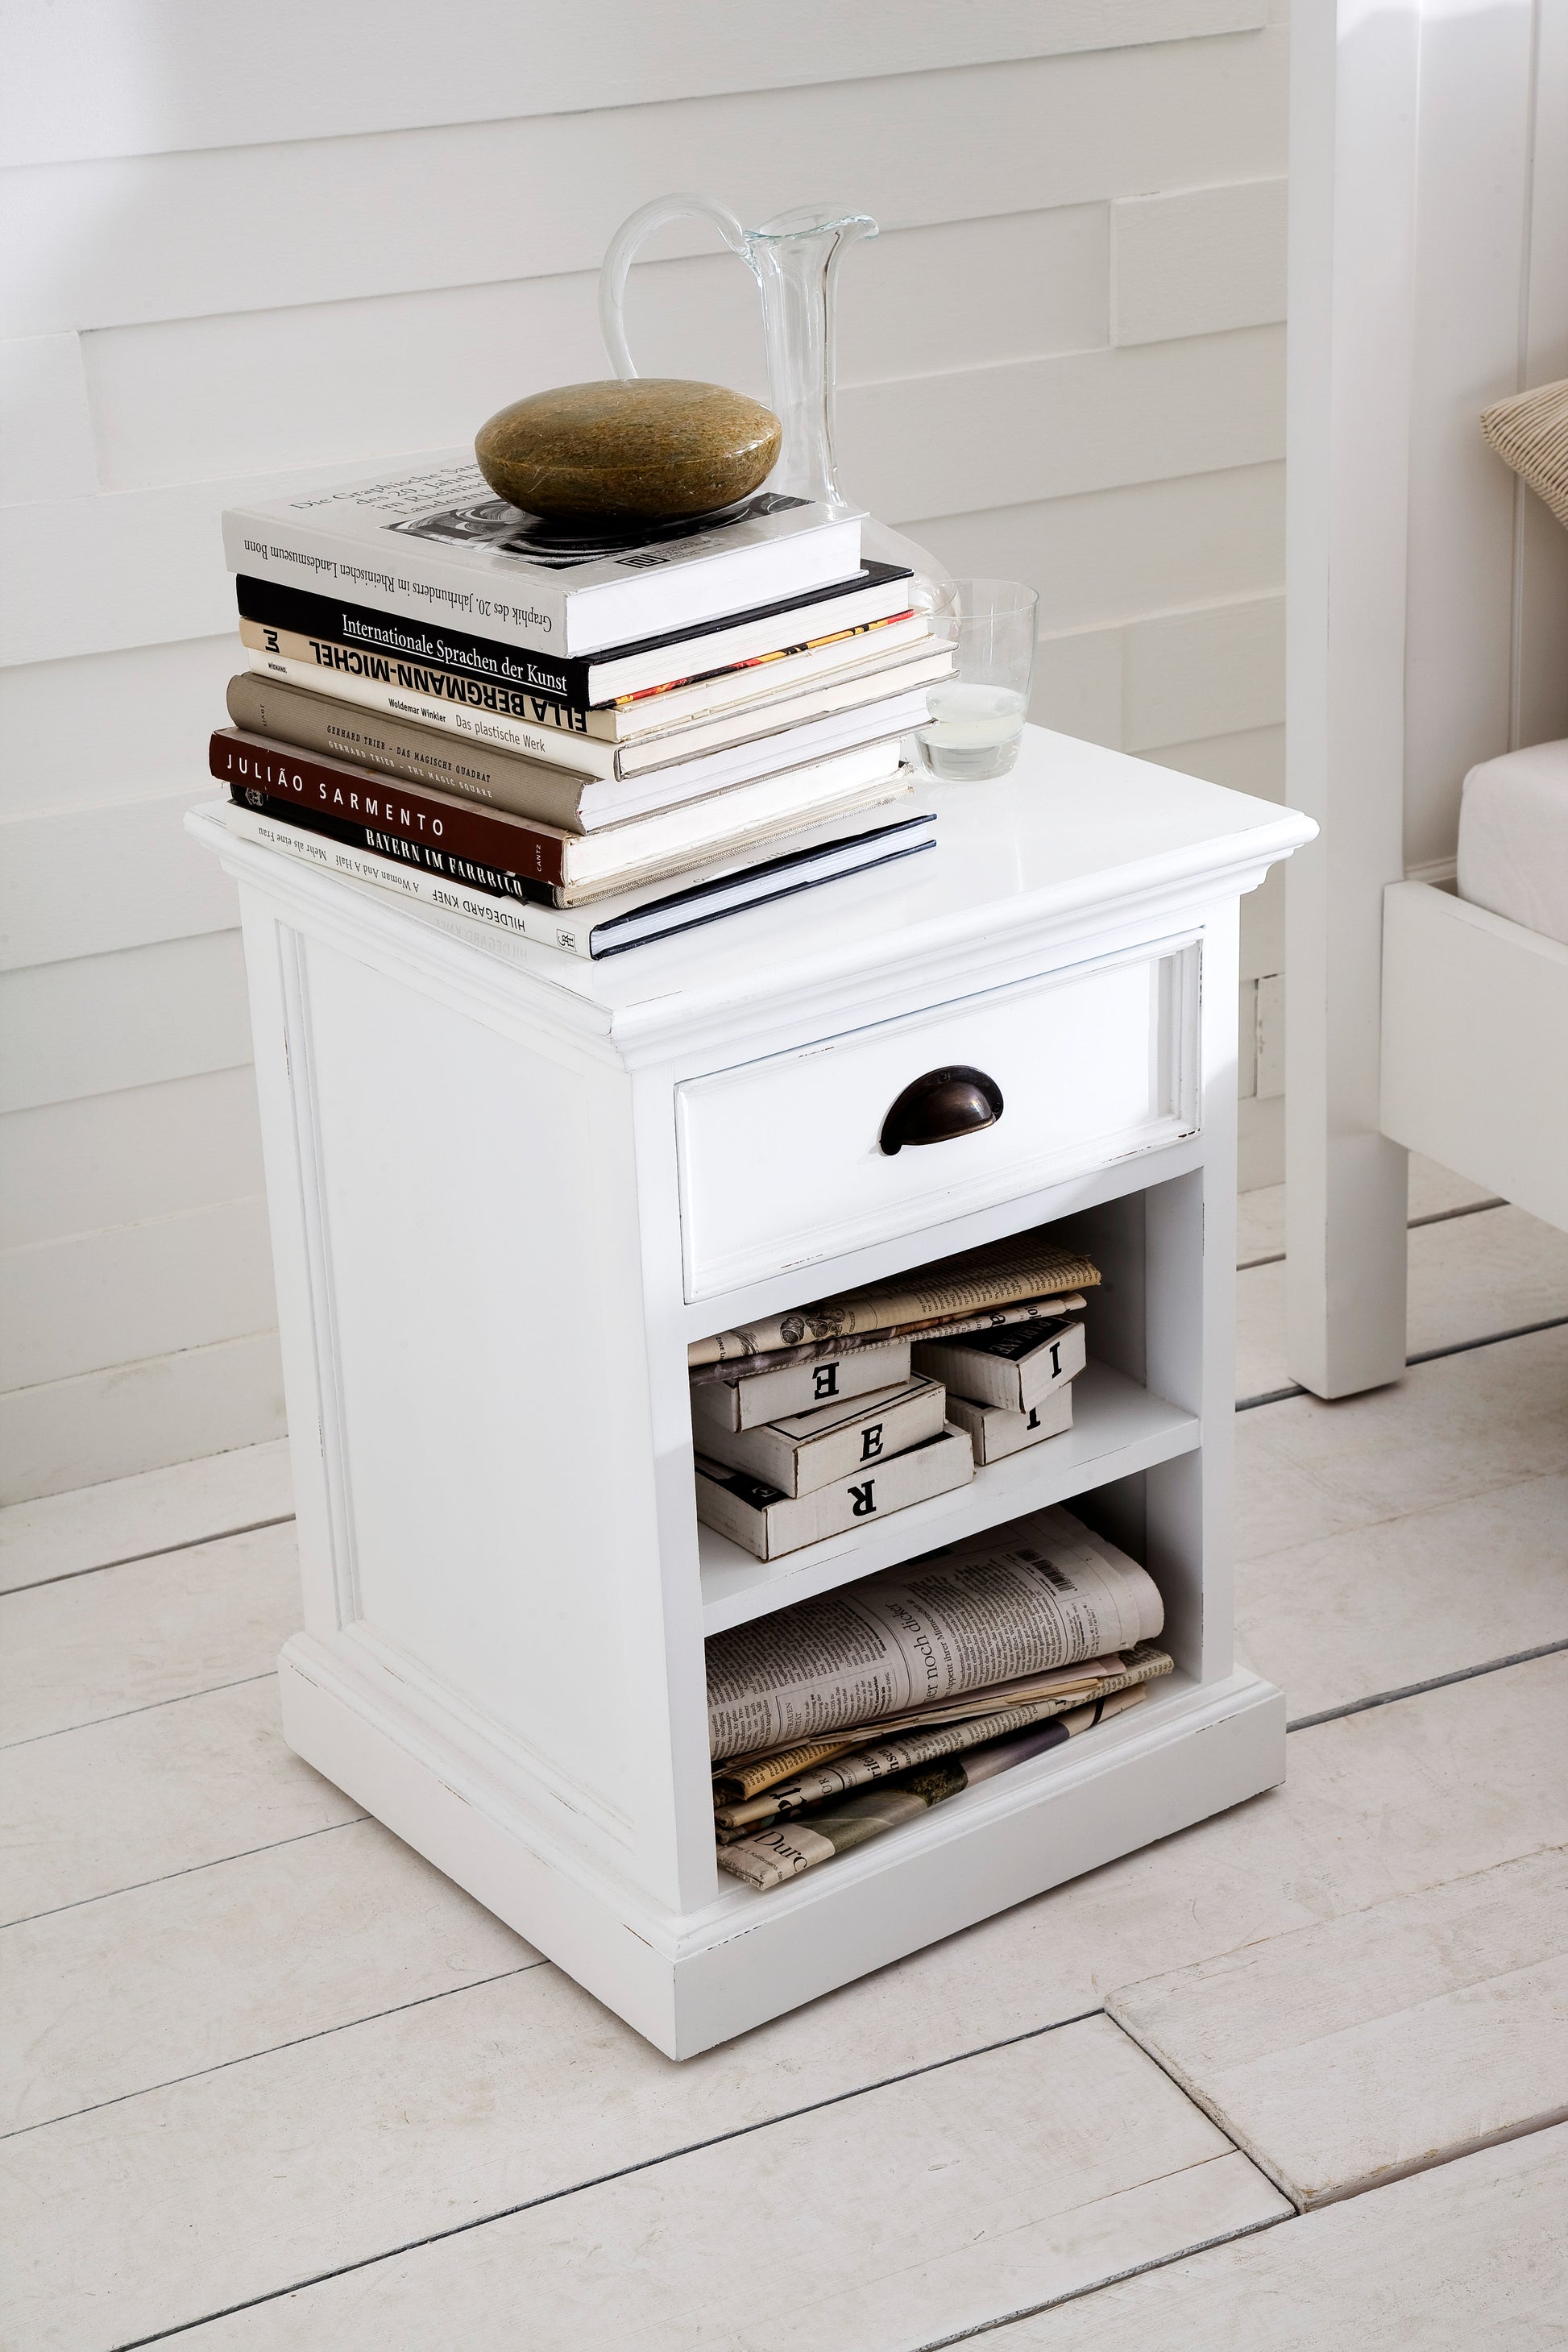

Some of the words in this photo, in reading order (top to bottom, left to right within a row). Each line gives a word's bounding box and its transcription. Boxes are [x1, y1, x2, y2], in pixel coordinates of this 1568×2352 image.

[288, 497, 332, 510] Die
[333, 473, 442, 500] Graphische
[355, 495, 389, 506] des
[371, 500, 405, 510] im
[243, 539, 268, 560] Bonn
[271, 546, 338, 578] Landesmuseum
[340, 564, 395, 593] Rheinischen
[397, 579, 410, 597] im
[413, 583, 474, 613] Jahrhunderts
[494, 603, 509, 622] des
[512, 607, 552, 633] Graphik
[341, 613, 433, 655] Internationale
[437, 639, 498, 673] Sprachen
[501, 657, 524, 679] der
[526, 663, 568, 692] Kunst
[309, 641, 526, 718] BERGMANN-MICHEL
[388, 697, 420, 716] Woldemar
[421, 707, 446, 724] Winkler
[530, 696, 588, 733] ELLA
[455, 714, 472, 732] Das
[475, 721, 521, 745] plastische
[522, 733, 546, 753] Werk
[326, 724, 361, 742] GERHARD
[363, 736, 386, 751] TRIEB
[396, 746, 411, 759] DAS
[414, 752, 452, 771] MAGISCHE
[455, 765, 492, 783] QUADRAT
[328, 740, 367, 759] GERHARD
[369, 753, 395, 767] TRIEB
[407, 765, 425, 778] THE
[428, 771, 456, 787] MAGIC
[458, 781, 493, 799] SQUARE
[226, 753, 304, 792] JULIÃO
[319, 782, 443, 836] SARMENTO
[258, 827, 275, 843] Frau
[276, 834, 292, 848] eine
[293, 840, 305, 852] als
[306, 846, 327, 861] Mehr
[335, 854, 353, 869] Half
[355, 861, 362, 873] A
[365, 828, 421, 863] BAYERN
[425, 848, 445, 871] IM
[448, 856, 523, 898] FARBBILD
[531, 844, 541, 873] CANTZ
[363, 865, 379, 878] And
[381, 871, 410, 891] Woman
[412, 881, 420, 893] A
[432, 889, 460, 909] KNEF
[463, 900, 526, 932] HILDEGARD
[811, 1361, 840, 1400] E
[859, 1423, 884, 1462] E
[847, 1479, 877, 1516] R
[886, 1604, 920, 1632] dicker
[914, 1604, 944, 1640] Mitmenschen
[972, 1620, 982, 1636] eigener
[1023, 1610, 1036, 1639] geschlossen.
[1032, 1617, 1044, 1646] gefährlicher
[1052, 1619, 1062, 1645] schlechtes
[959, 1632, 970, 1661] Süßigkeiten
[979, 1637, 988, 1654] Gefühl
[982, 1626, 992, 1647] Wunsch
[998, 1632, 1006, 1651] eigenen
[1017, 1629, 1026, 1660] wohlbeleibte
[915, 1636, 938, 1679] noch
[941, 1642, 952, 1661] ihrer
[973, 1635, 985, 1674] psychologischen
[946, 1663, 956, 1689] Appetit
